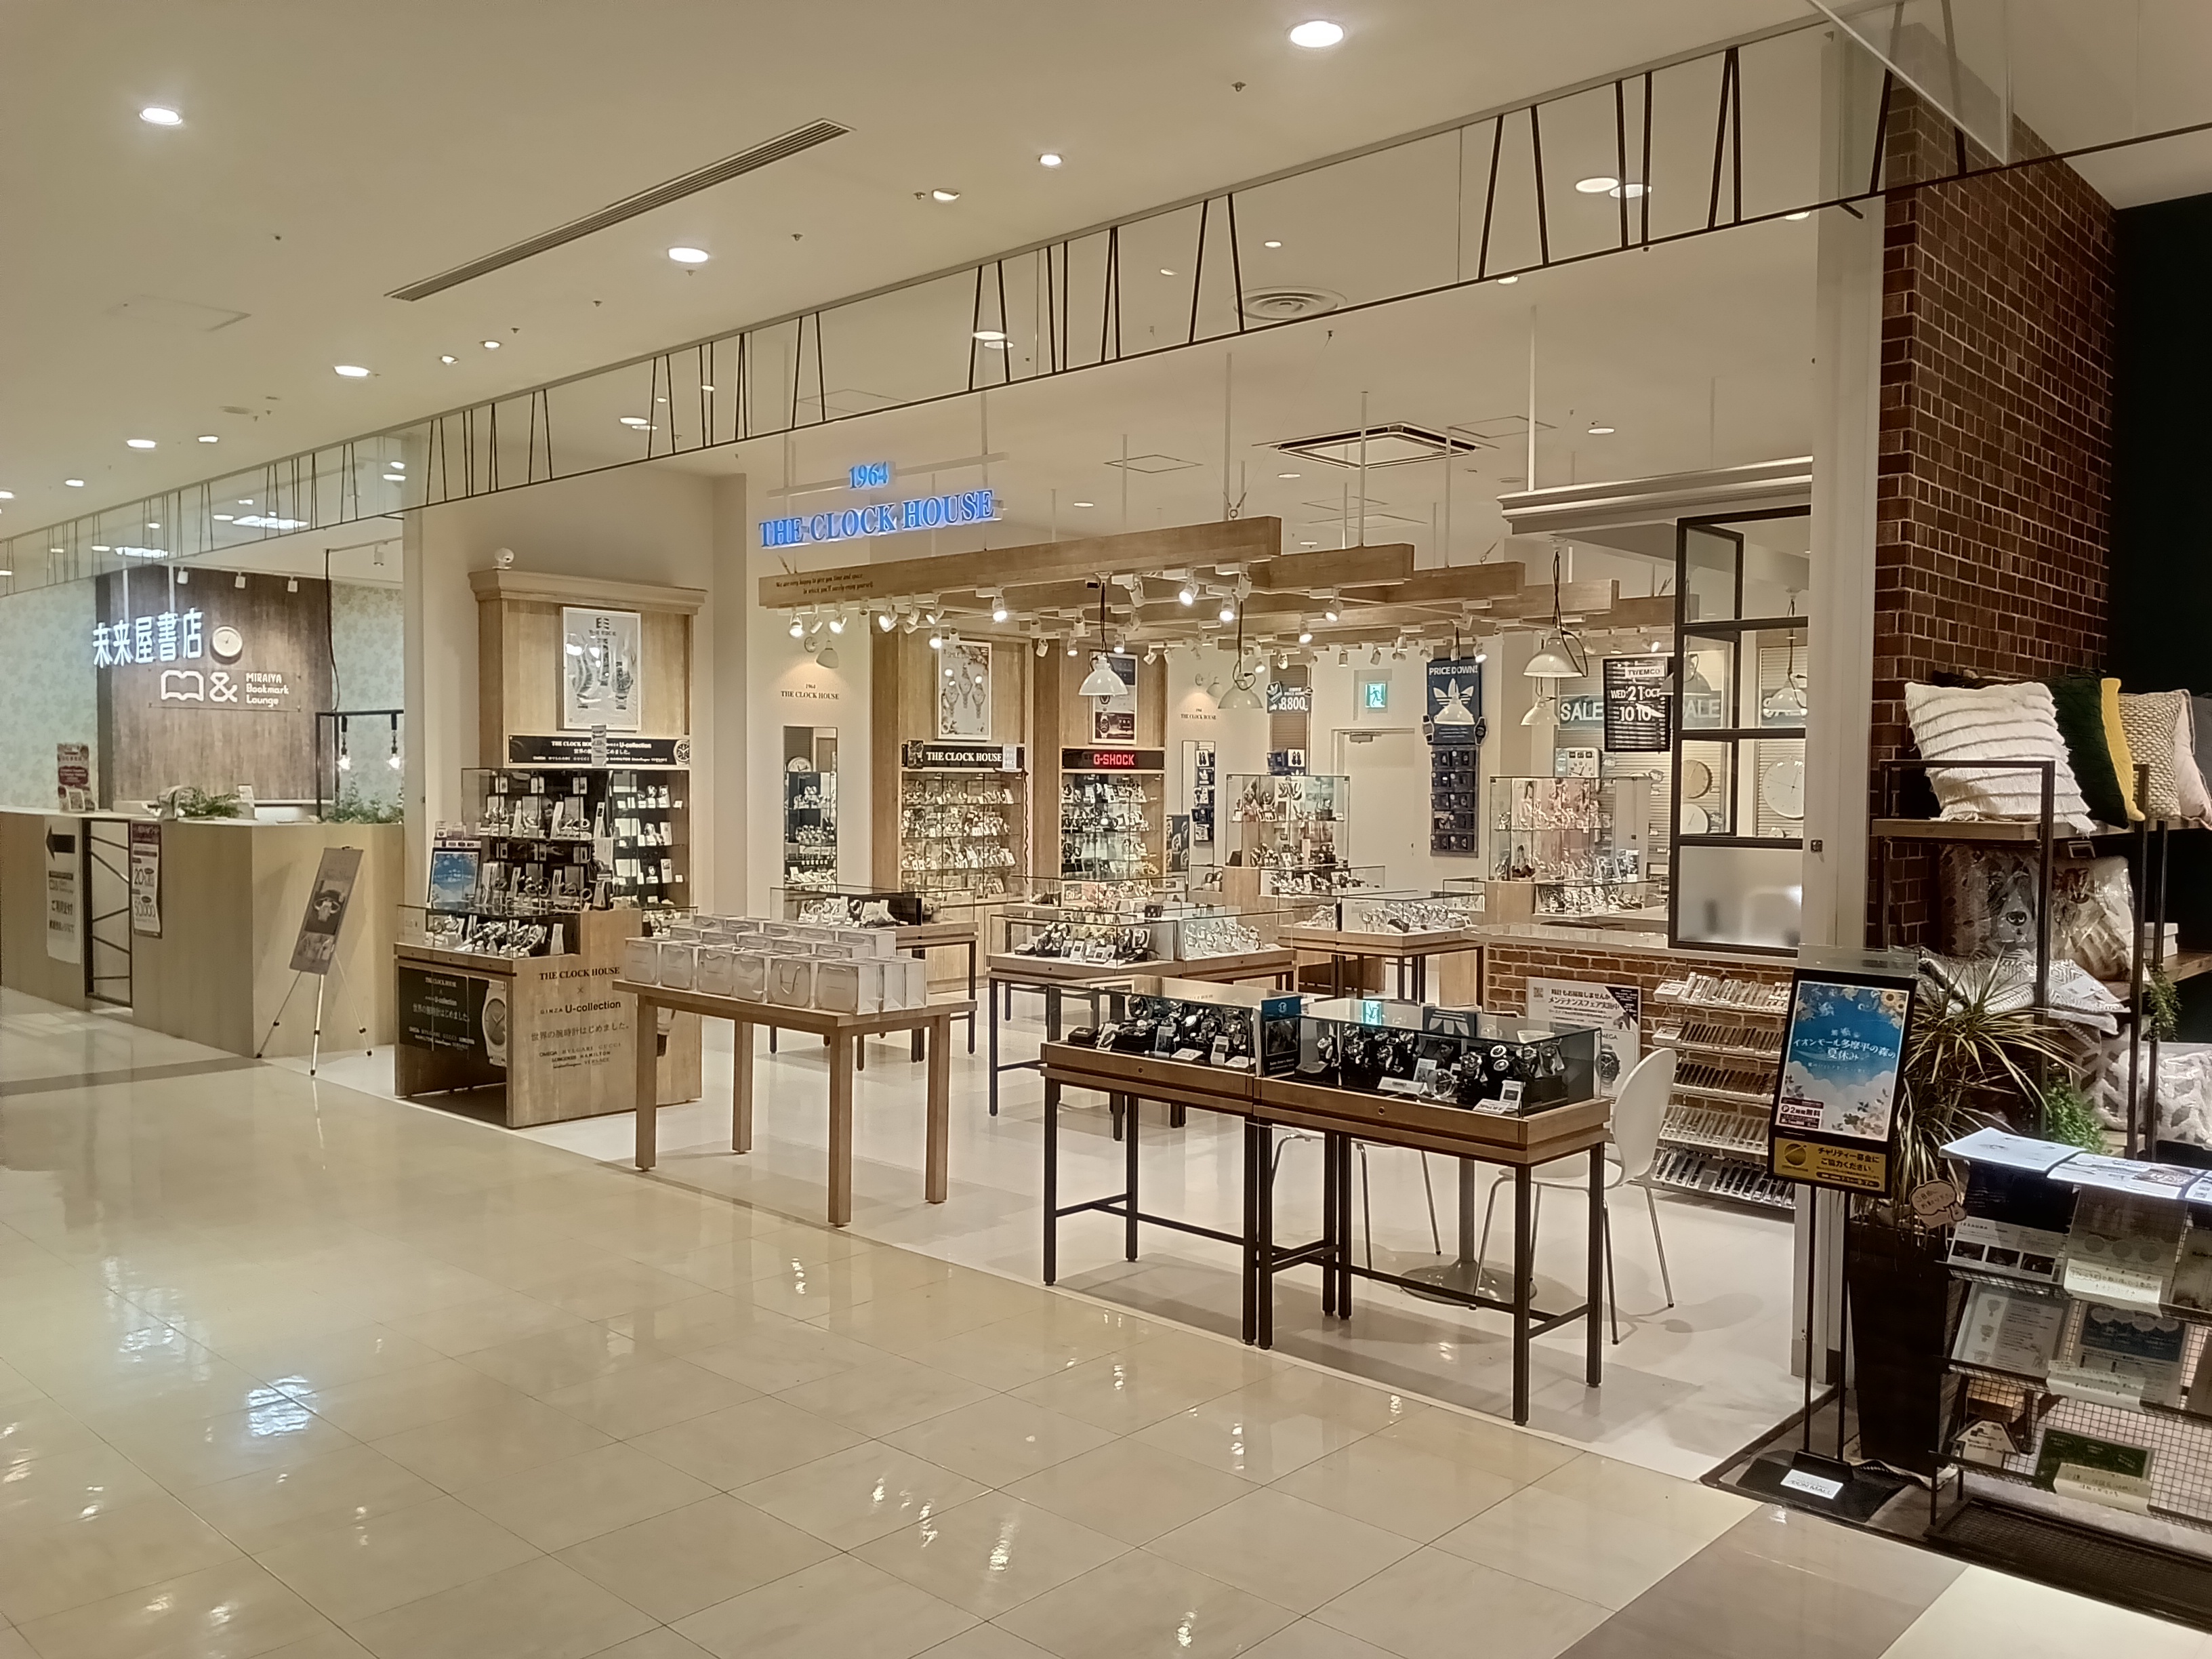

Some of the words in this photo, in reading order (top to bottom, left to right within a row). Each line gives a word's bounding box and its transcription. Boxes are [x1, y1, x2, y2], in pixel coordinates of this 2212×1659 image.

[848, 461, 889, 489] 1964
[758, 517, 804, 548] THE
[810, 504, 896, 541] CLOCK
[903, 490, 995, 529] HOUSE
[93, 607, 205, 668] 未来屋書店
[1429, 666, 1451, 676] PRICE
[1451, 664, 1479, 675] DOWN!
[1627, 668, 1662, 676] TWEMCO
[245, 672, 282, 684] MIRAIYA
[245, 684, 289, 695] Bookmark
[818, 692, 840, 700] HOUSE
[1610, 687, 1627, 699] WED
[1628, 685, 1643, 701] 21
[1644, 687, 1661, 699] OCT
[245, 695, 279, 708] Lounge
[1684, 699, 1721, 718] ALE
[1560, 701, 1604, 722] SALE
[1619, 705, 1635, 722] 10
[926, 751, 943, 761] THE
[945, 752, 975, 762] CLOCK
[976, 752, 1002, 762] HOUSE
[1092, 754, 1135, 766] G-SHOCK
[539, 971, 558, 981] THE
[559, 968, 590, 979] CLOCK
[591, 966, 620, 976] HOUSE
[565, 1000, 621, 1014] U-collection
[1596, 1032, 1619, 1040] OMEGA
[539, 1050, 558, 1058] OMEGA
[1793, 1038, 1896, 1059] イオンモール多摩平の森の
[1827, 1046, 1860, 1061] 夏休み
[1818, 1147, 1880, 1164] チャリティー募金に
[1820, 1157, 1875, 1173] ご協力ください。
